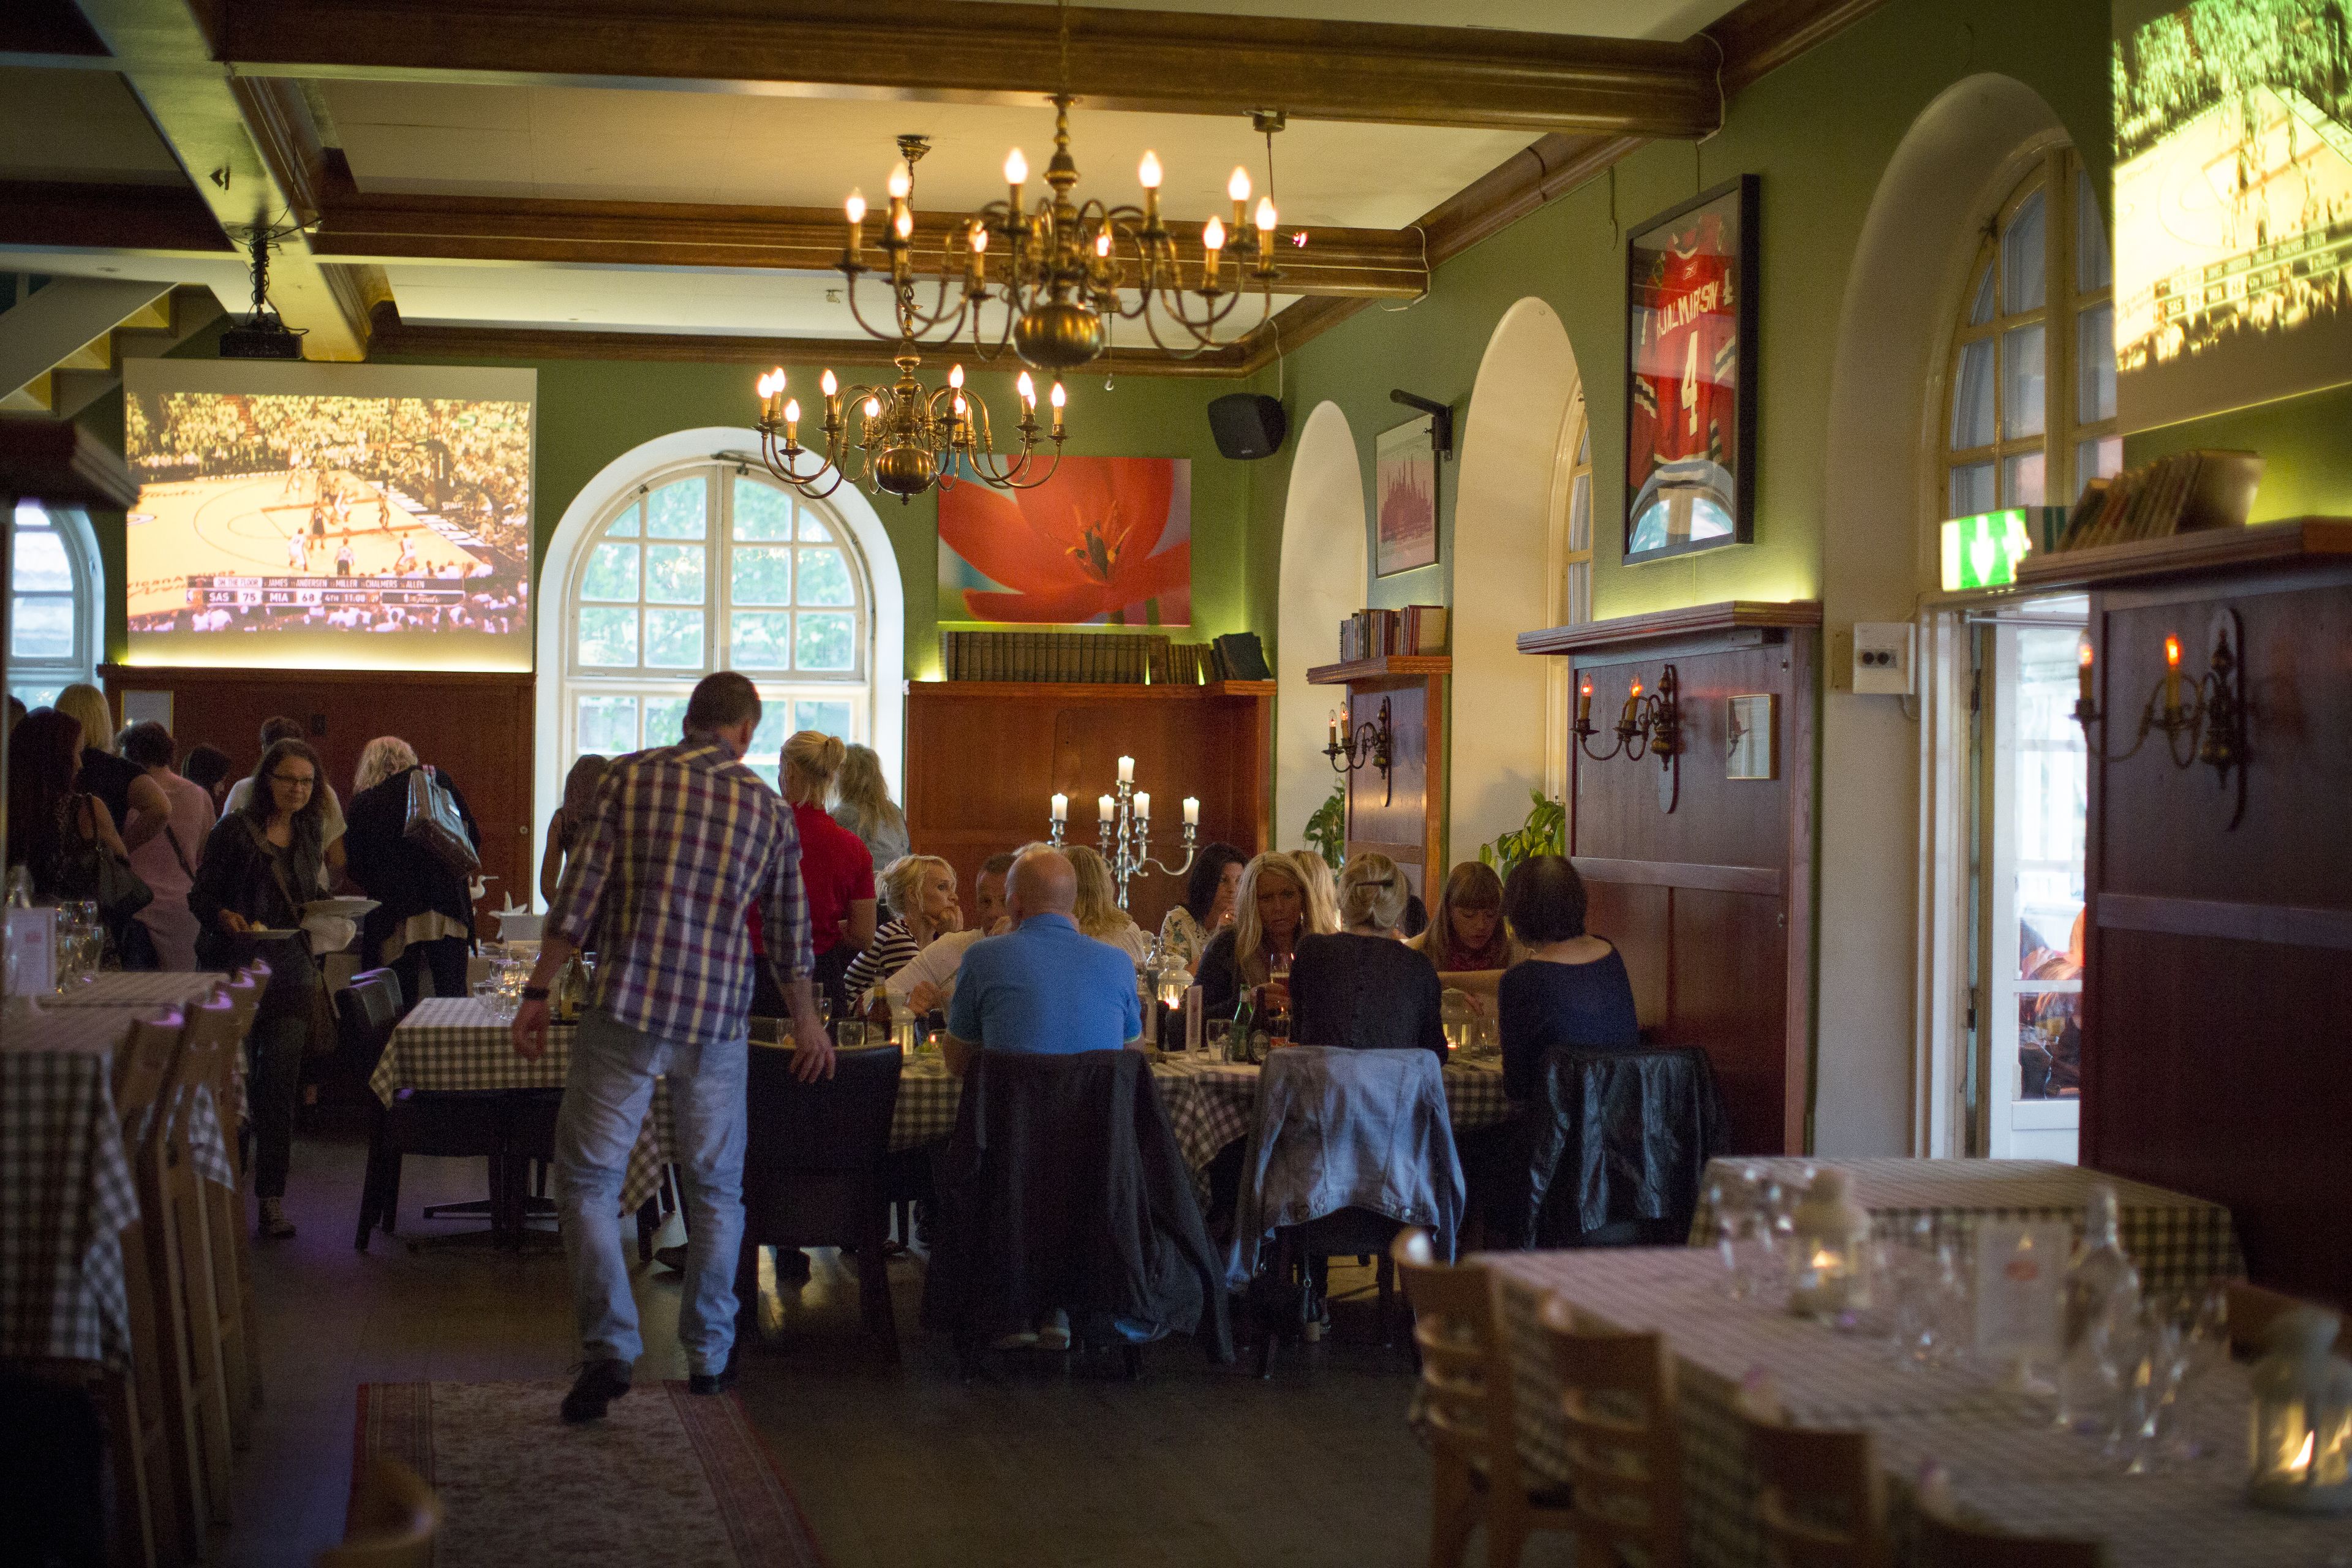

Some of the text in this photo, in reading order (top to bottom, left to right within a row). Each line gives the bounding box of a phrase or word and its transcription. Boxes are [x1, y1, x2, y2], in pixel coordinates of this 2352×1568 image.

[1681, 330, 1698, 437] 4
[268, 578, 288, 587] JAMES
[405, 580, 425, 589] ALLEN
[209, 592, 230, 602] SAS
[243, 593, 256, 601] 75
[270, 592, 288, 602] MIA
[302, 593, 315, 602] 68
